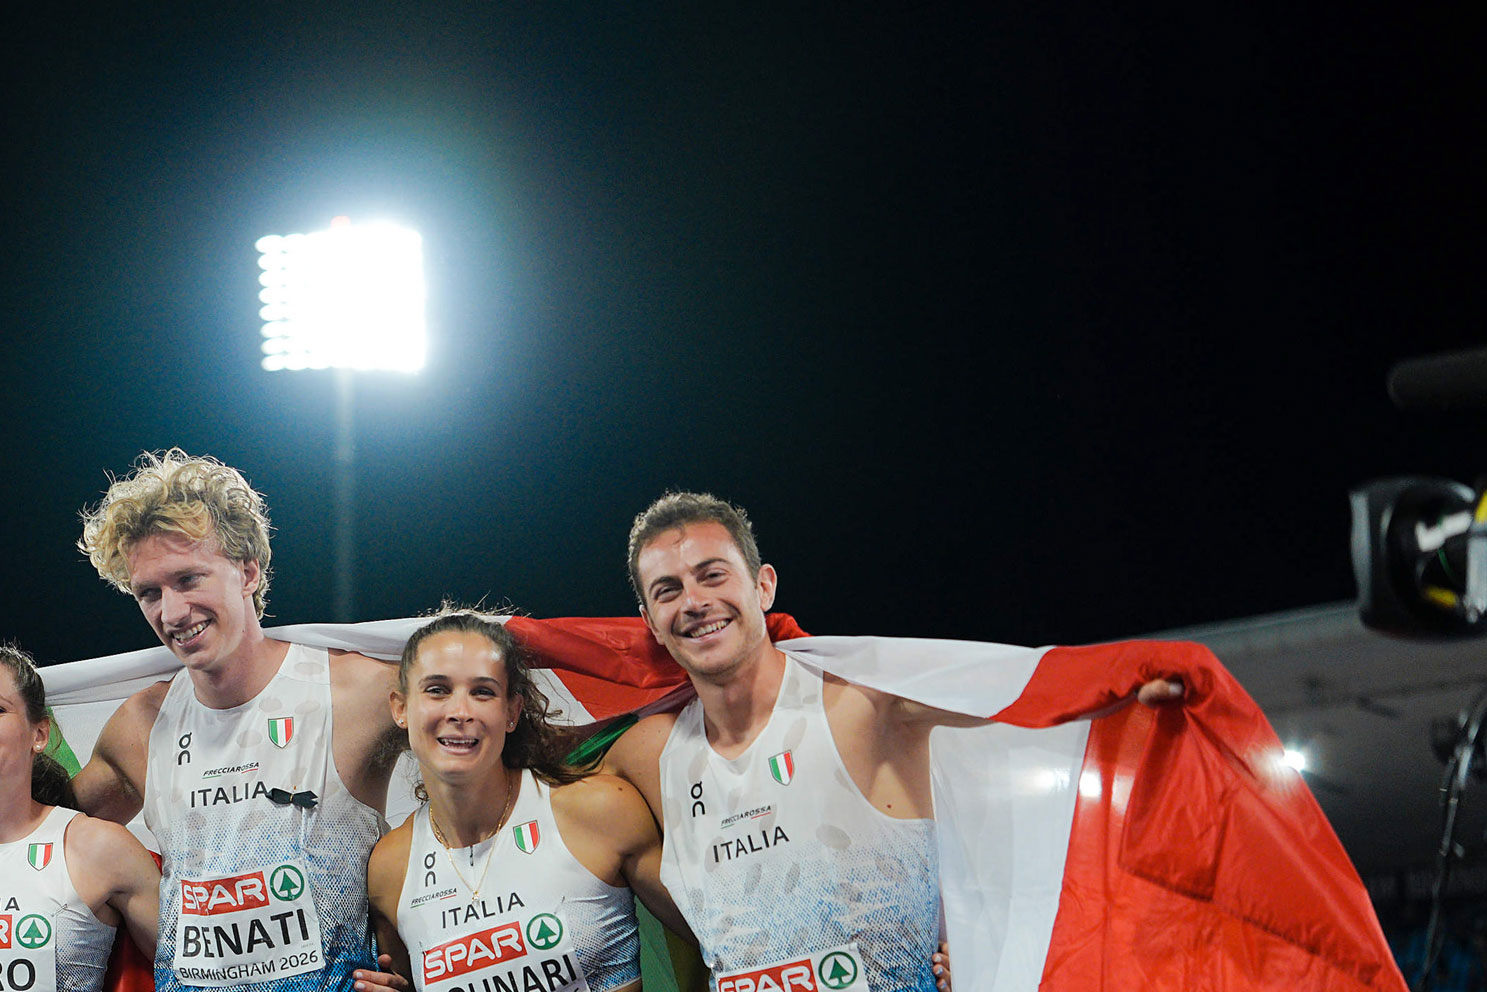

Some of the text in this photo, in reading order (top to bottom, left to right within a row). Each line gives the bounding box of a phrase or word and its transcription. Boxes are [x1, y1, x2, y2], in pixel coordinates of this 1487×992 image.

[190, 781, 269, 809] ITALIA
[713, 826, 790, 863] ITALIA
[183, 877, 264, 910] SPAR
[442, 892, 525, 929] ITALIA
[182, 908, 309, 958] BENATI
[179, 950, 318, 980] BIRMINGHAM 2026
[425, 927, 523, 979] SPAR
